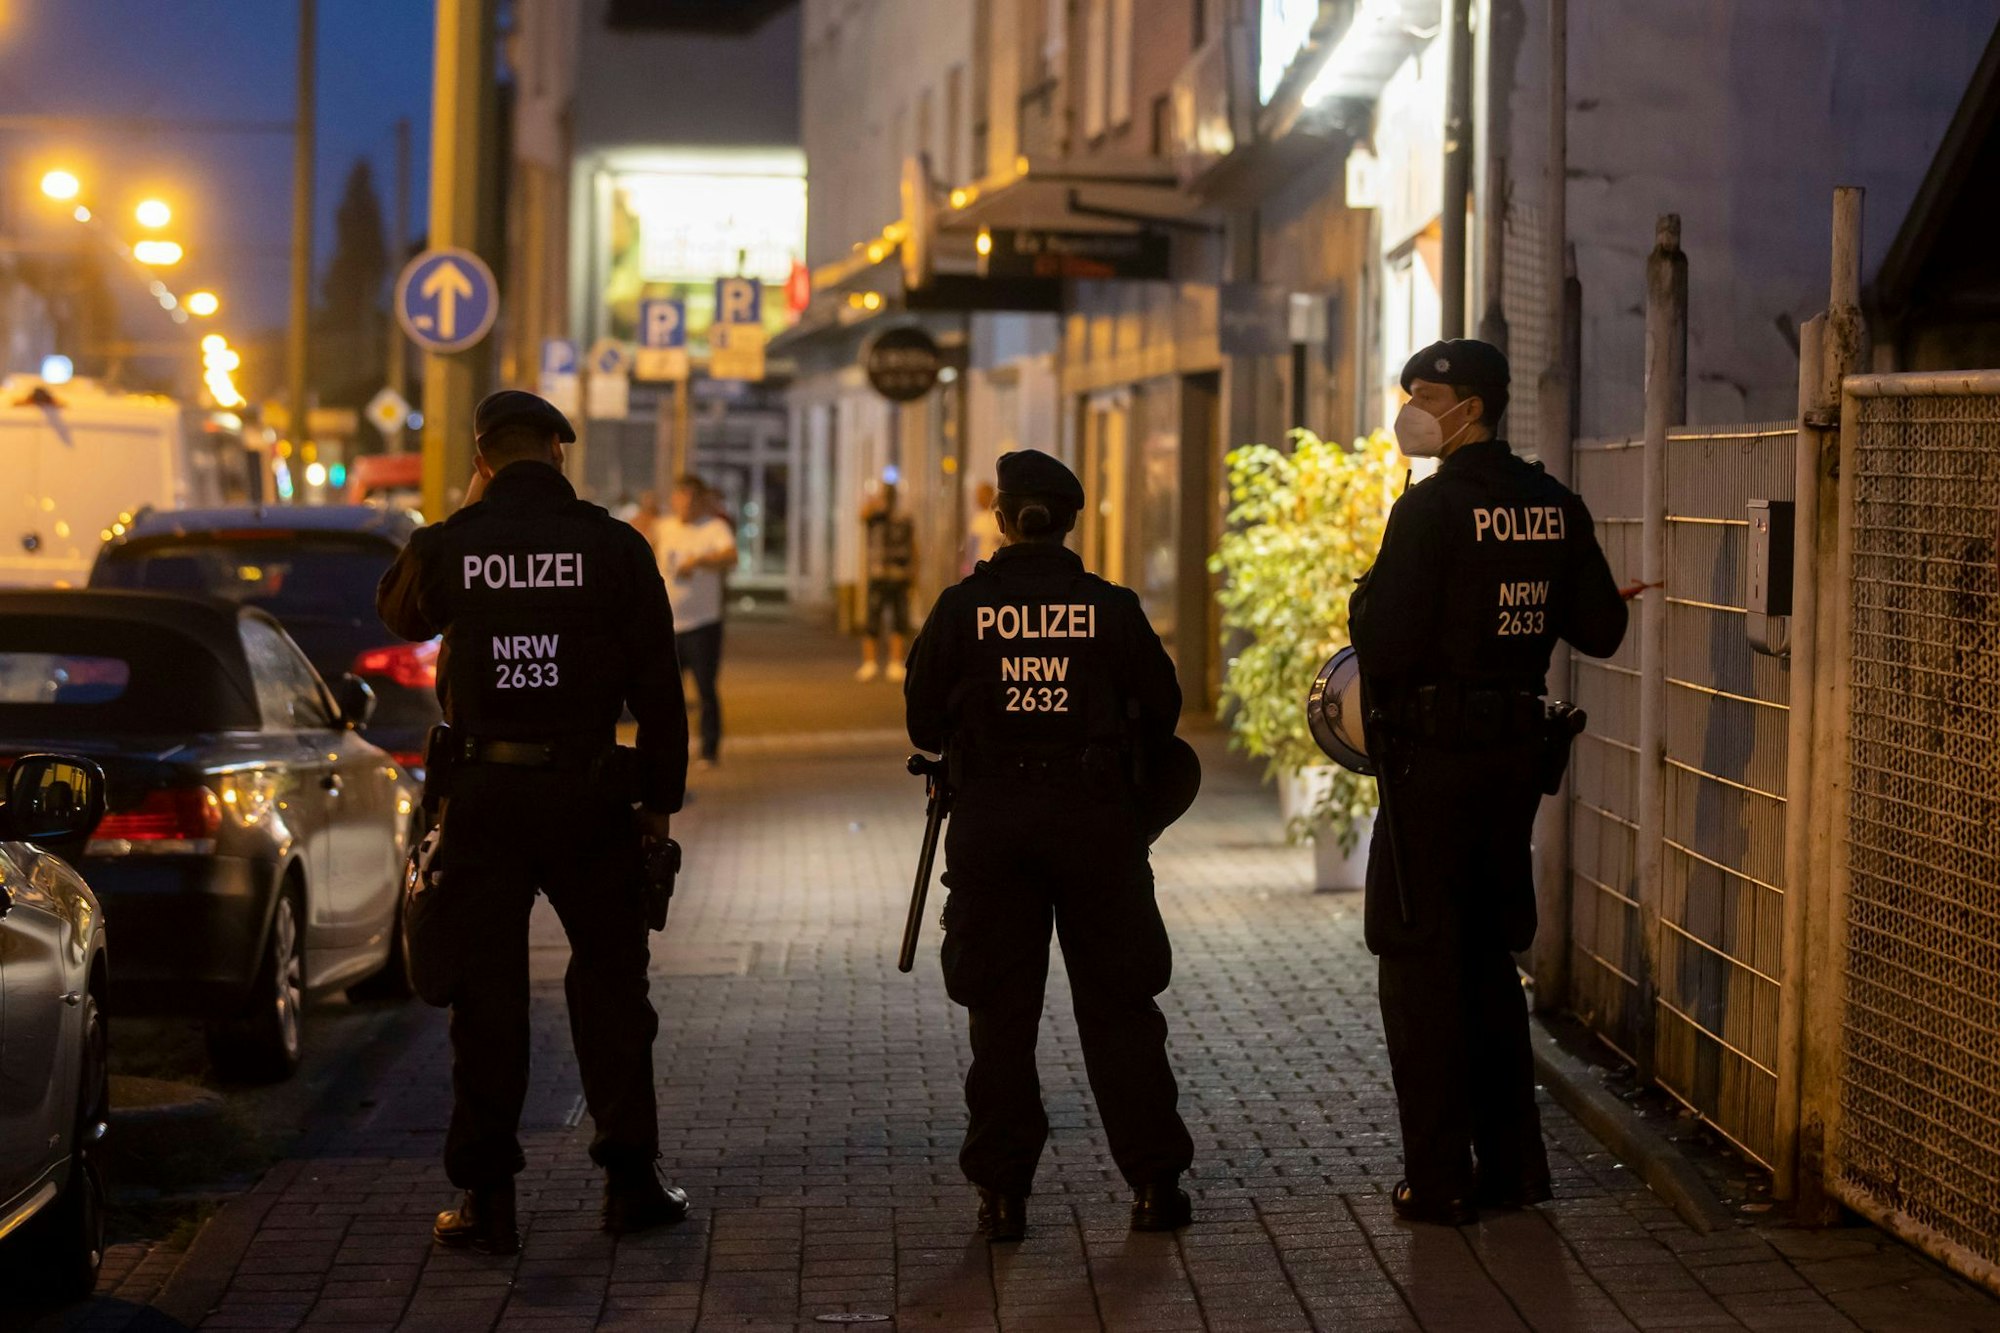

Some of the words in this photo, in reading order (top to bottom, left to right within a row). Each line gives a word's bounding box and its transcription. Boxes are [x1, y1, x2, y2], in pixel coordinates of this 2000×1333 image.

[646, 303, 679, 346] P
[1473, 507, 1565, 542] POLIZEI
[463, 552, 583, 590] POLIZEI
[1499, 581, 1549, 607] NRW
[976, 604, 1095, 640] POLIZEI
[1497, 611, 1544, 636] 2633
[492, 634, 559, 660] NRW
[495, 662, 559, 689] 2633
[1001, 656, 1070, 682] NRW
[1005, 686, 1069, 712] 2632
